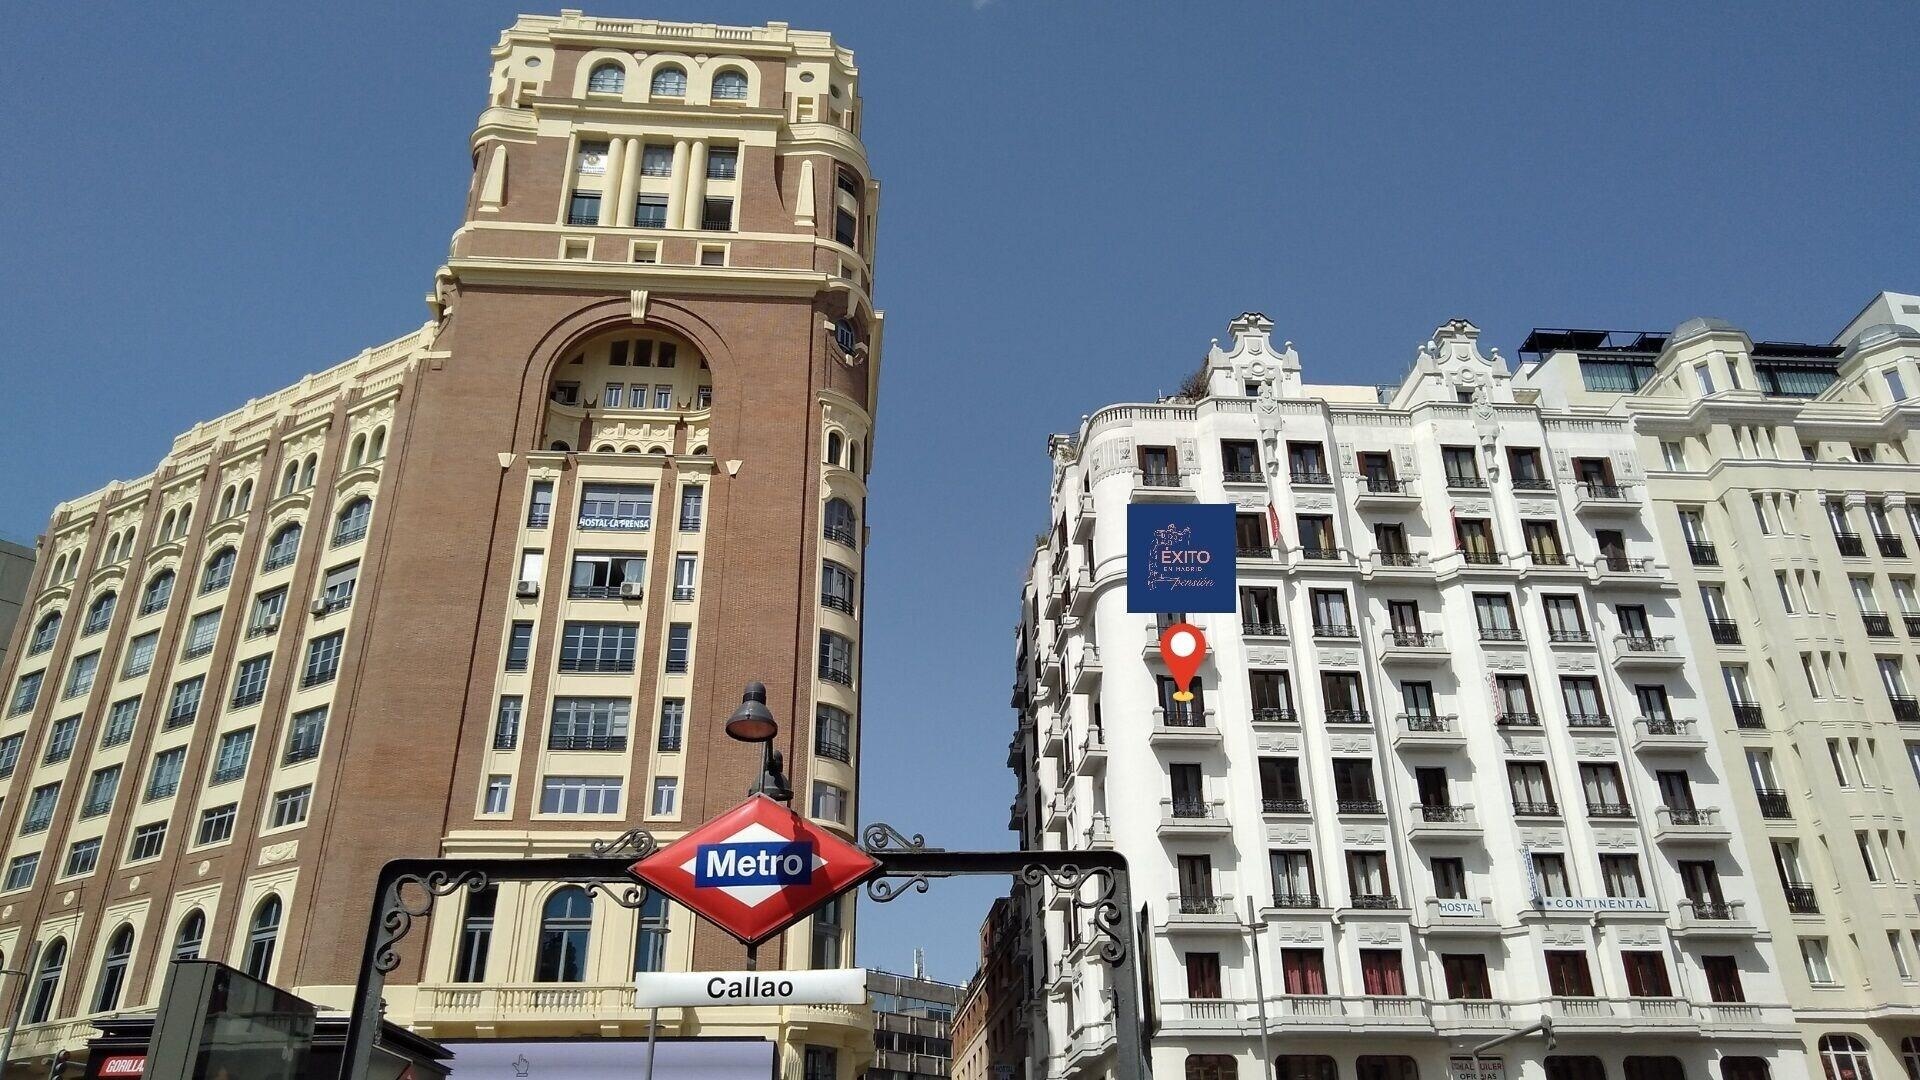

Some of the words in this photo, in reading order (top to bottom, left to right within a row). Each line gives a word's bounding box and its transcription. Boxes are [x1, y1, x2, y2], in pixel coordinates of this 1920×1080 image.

[579, 517, 608, 527] HOSTAL
[620, 519, 649, 528] PRENSA
[706, 849, 803, 878] Metro
[1439, 902, 1481, 912] HOSTAL
[1555, 899, 1652, 909] CONTINENTAL
[706, 976, 794, 999] Callao
[105, 1059, 145, 1073] GORILLA
[1465, 1062, 1502, 1071] ALUILER
